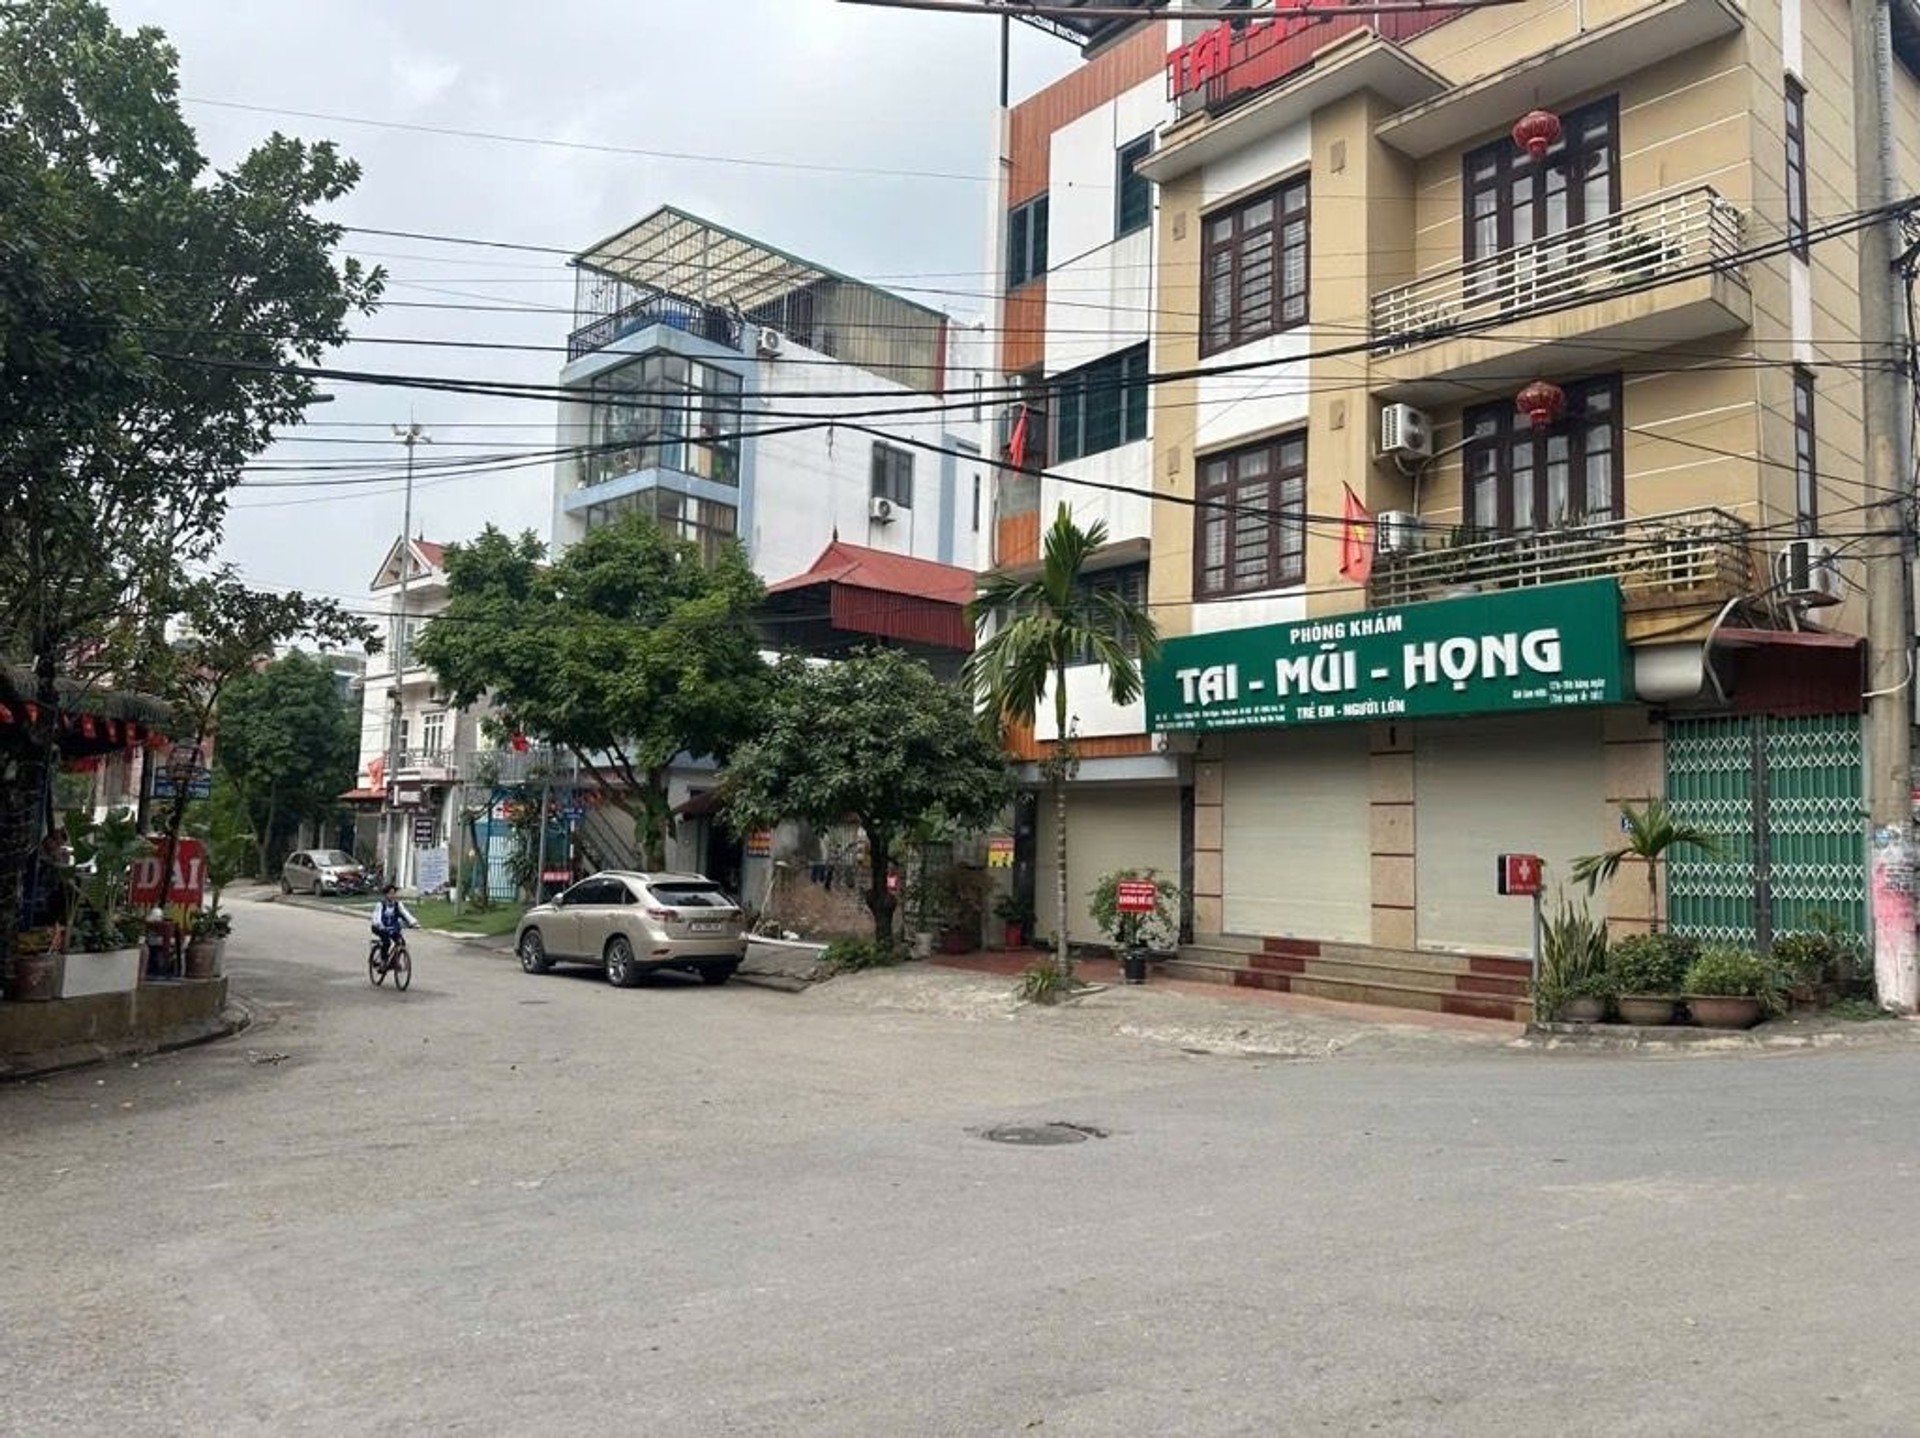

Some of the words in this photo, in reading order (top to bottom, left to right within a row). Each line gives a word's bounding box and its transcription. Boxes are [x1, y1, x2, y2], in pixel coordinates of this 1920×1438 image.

[1167, 19, 1231, 96] TAI
[1290, 622, 1346, 644] PHÒNG
[1350, 613, 1402, 637] KHÁM
[1175, 664, 1238, 707] TAI
[1276, 643, 1356, 695] MŨI
[1404, 628, 1561, 692] HỌNG
[1318, 705, 1336, 719] EM
[1343, 697, 1380, 718] NGƯỜI
[1381, 695, 1406, 715] LỚN
